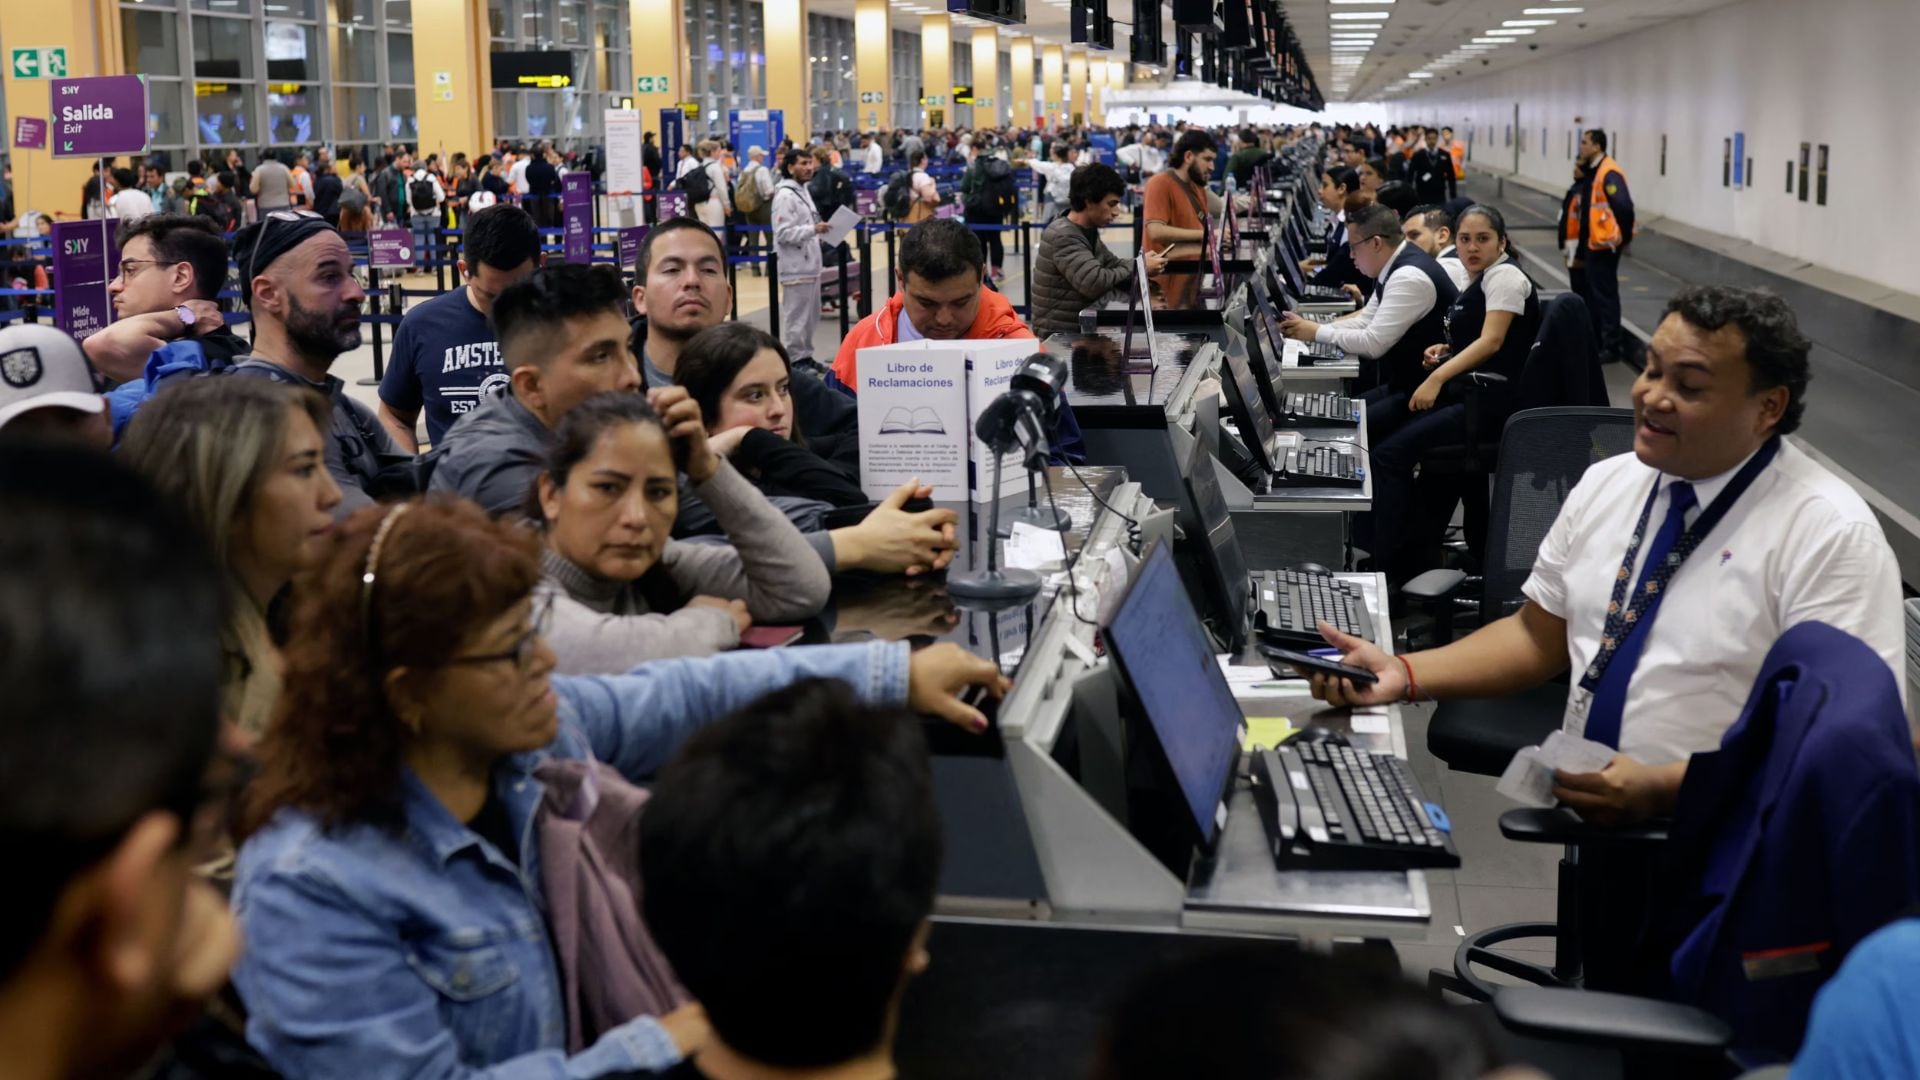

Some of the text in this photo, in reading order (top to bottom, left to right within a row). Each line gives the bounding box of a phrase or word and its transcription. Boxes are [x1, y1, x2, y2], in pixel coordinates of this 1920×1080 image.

[61, 85, 80, 95] SKY
[62, 103, 113, 121] Salida
[63, 124, 82, 134] Exit
[64, 238, 89, 255] SKY
[72, 305, 90, 318] Mide
[89, 316, 98, 326] tu
[442, 341, 504, 374] AMSTE
[887, 363, 933, 373] Libro de
[995, 359, 1013, 370] Libro
[868, 378, 953, 388] Reclamaciones
[451, 400, 476, 414] EST
